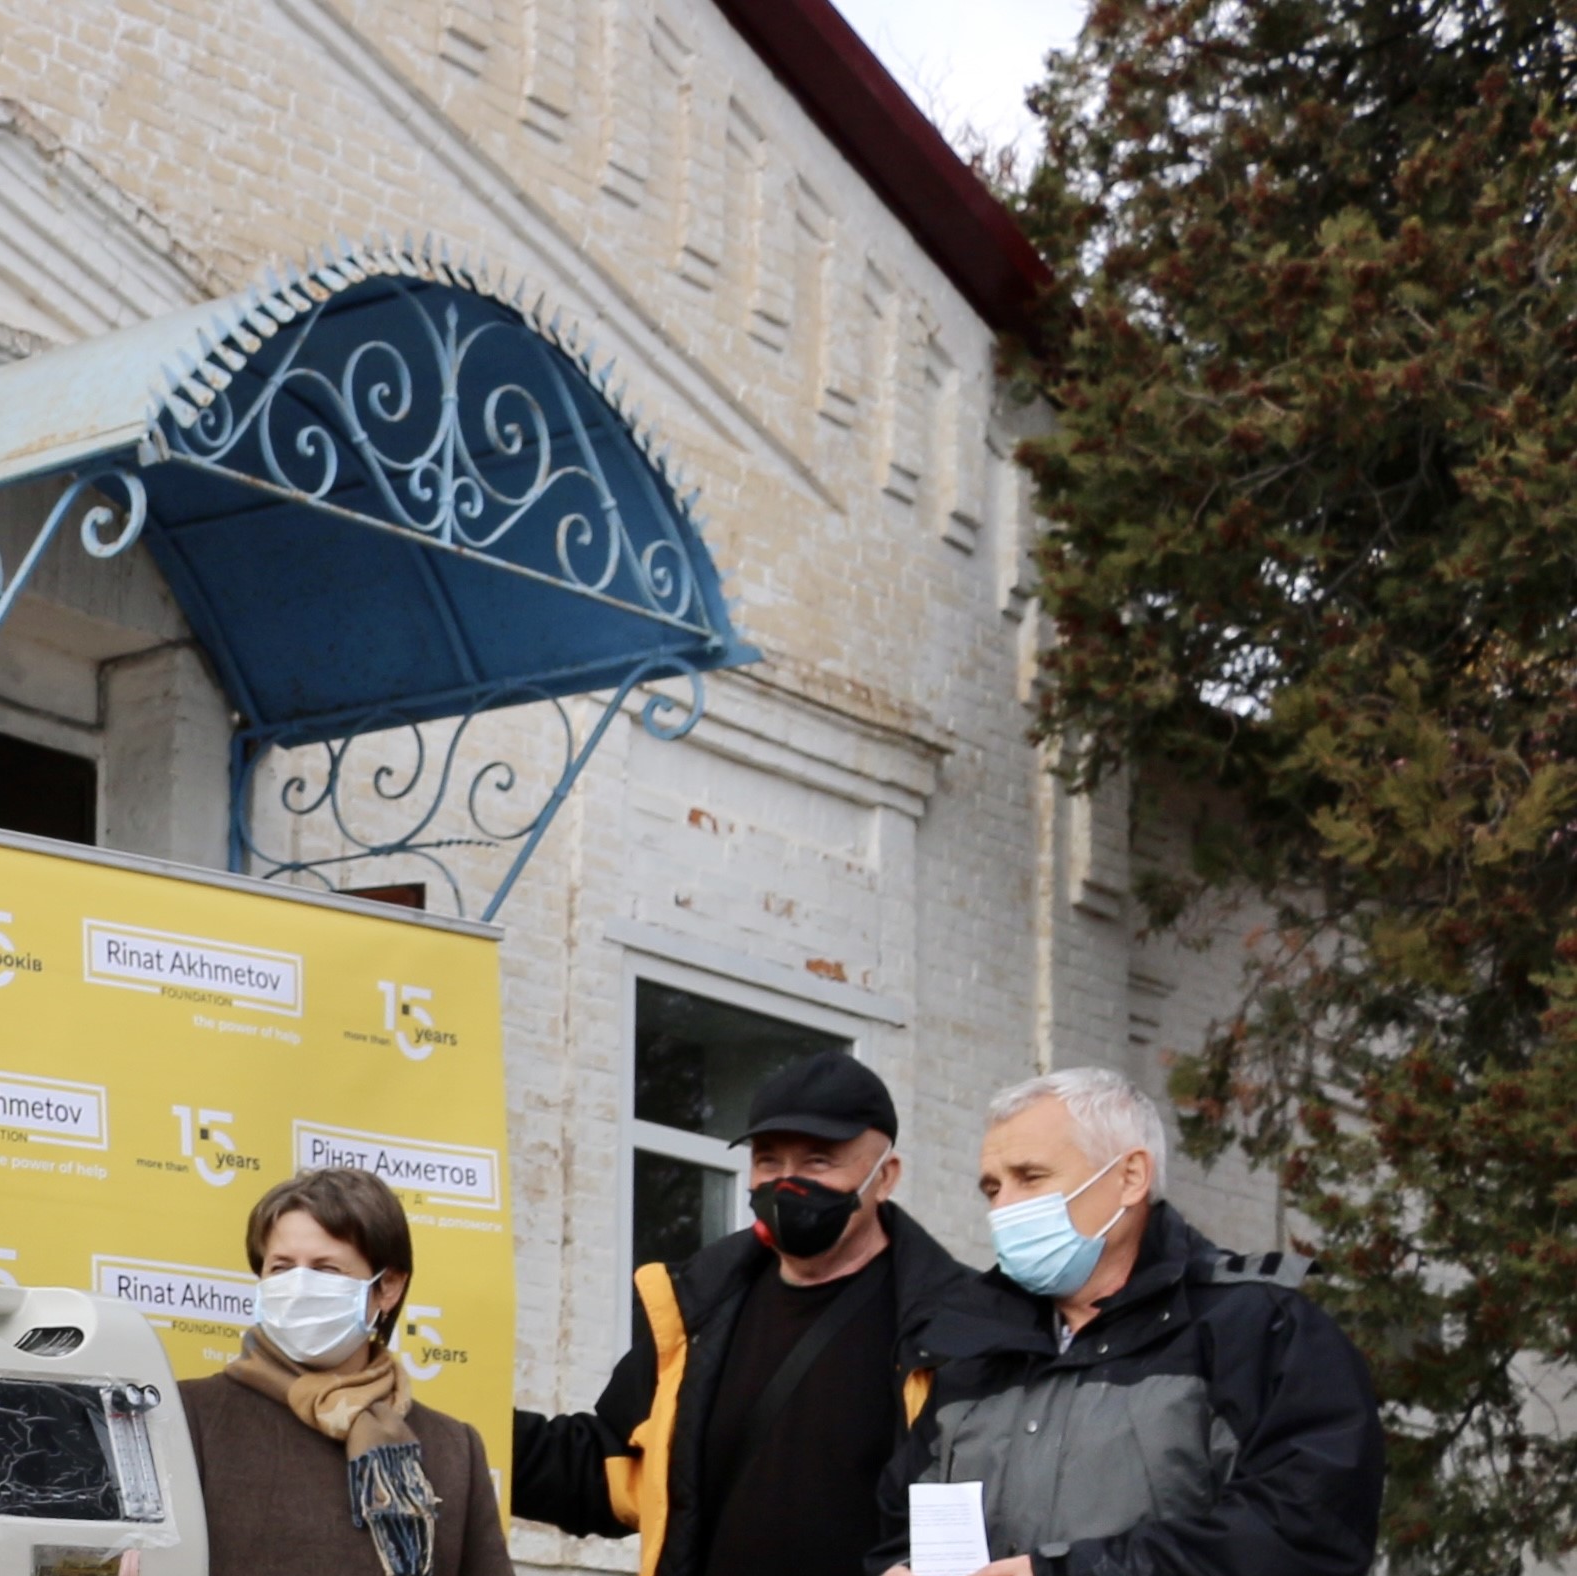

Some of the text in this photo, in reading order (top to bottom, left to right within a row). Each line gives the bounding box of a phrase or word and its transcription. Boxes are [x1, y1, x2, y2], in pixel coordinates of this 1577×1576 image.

[107, 939, 282, 992] Rinat Akhmetov
[160, 985, 233, 1008] FOUNDATION
[377, 980, 434, 1062] 15
[414, 1025, 459, 1047] years
[9, 1156, 55, 1176] power
[58, 1158, 73, 1175] of
[75, 1161, 109, 1181] help
[136, 1104, 261, 1188] more than 15 years
[311, 1138, 478, 1188] Рінат Ахметов
[117, 1274, 254, 1316] Rinat Akhme
[421, 1345, 469, 1364] years
